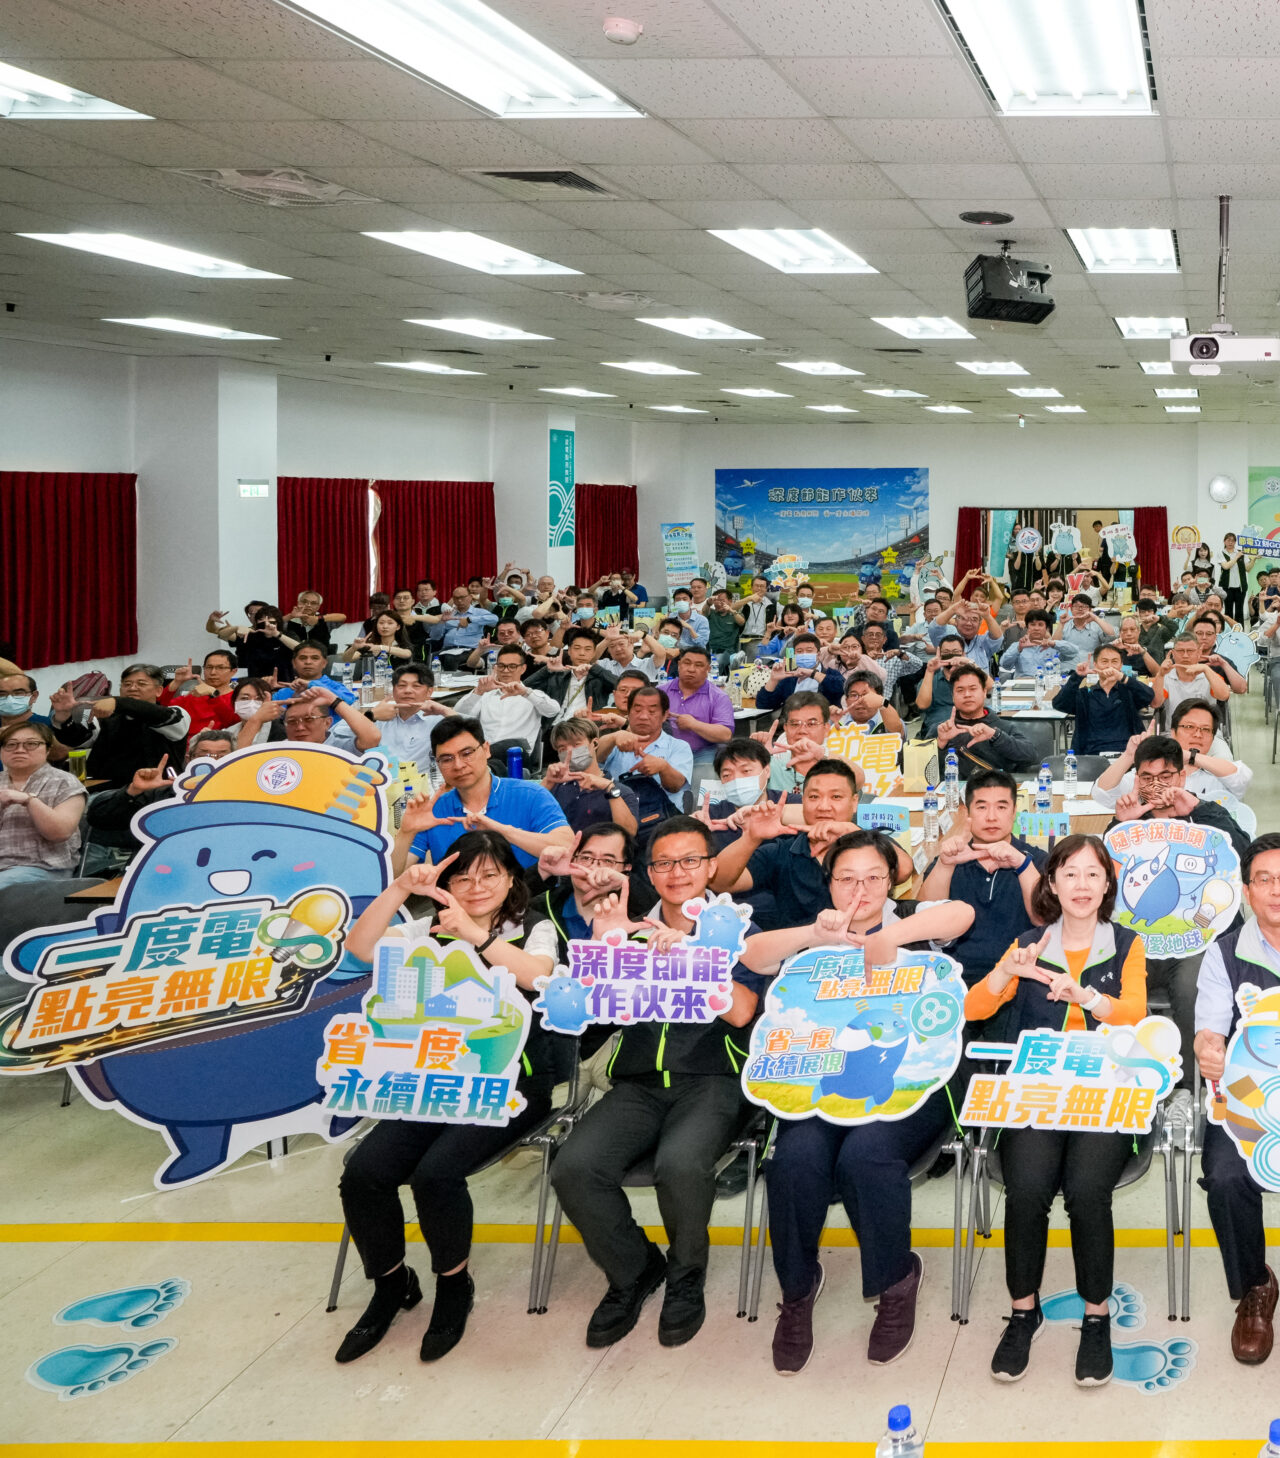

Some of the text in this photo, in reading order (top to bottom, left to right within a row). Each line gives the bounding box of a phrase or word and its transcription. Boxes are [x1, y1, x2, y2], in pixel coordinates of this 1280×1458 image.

[768, 487, 878, 503] 深度節能作伙來
[827, 723, 901, 773] 節電
[1109, 822, 1206, 853] 隨手拔插頭
[56, 907, 263, 973] 一度電
[571, 944, 730, 982] 深度節能
[785, 954, 866, 982] 一度電
[28, 956, 274, 1039] 點亮無限
[590, 984, 708, 1020] 作伙來
[816, 965, 926, 1001] 點亮無限
[327, 1021, 464, 1072] 省一度
[764, 1027, 835, 1053] 省一度
[970, 1033, 1107, 1079] 一度電
[751, 1051, 846, 1081] 永續展現
[325, 1067, 511, 1122] 永續展現
[965, 1082, 1157, 1130] 點亮無限
